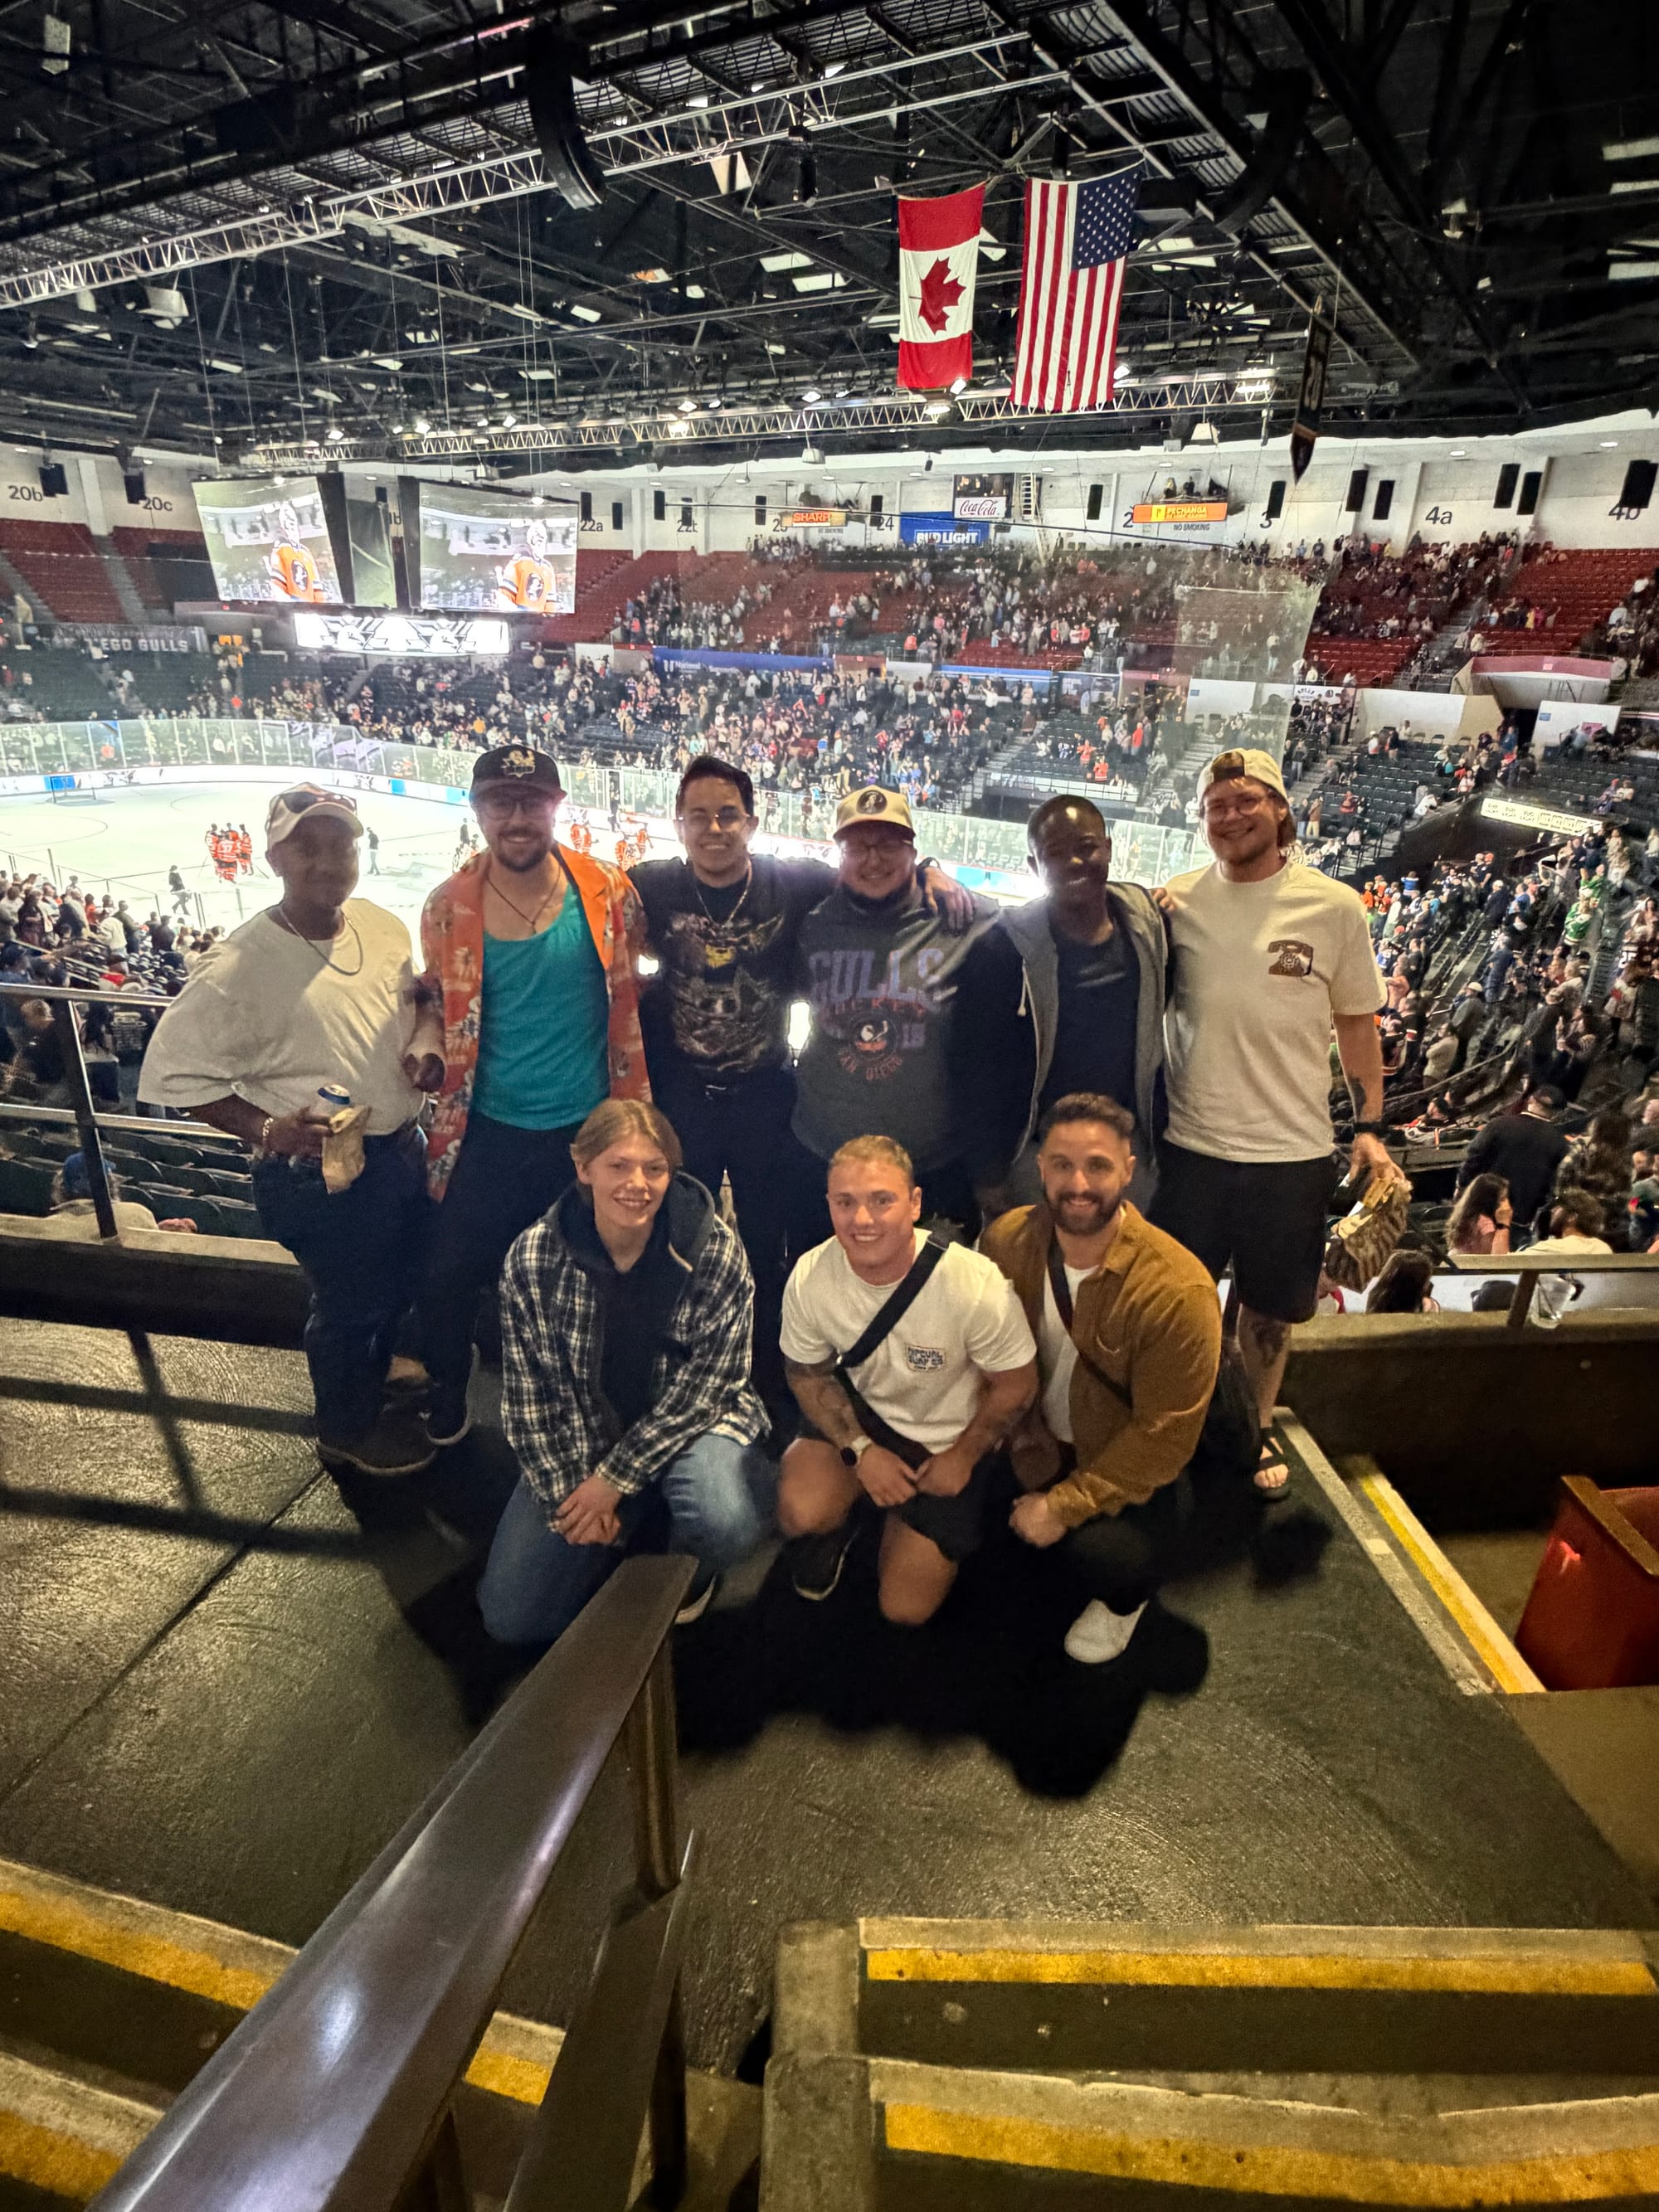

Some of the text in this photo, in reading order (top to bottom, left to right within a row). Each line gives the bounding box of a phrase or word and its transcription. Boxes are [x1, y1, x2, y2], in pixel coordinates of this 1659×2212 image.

[7, 485, 43, 502] 20b
[143, 497, 173, 511] 20c
[792, 512, 830, 523] SHARP
[1425, 506, 1452, 524] 4a
[1608, 503, 1641, 521] 4b
[580, 518, 603, 532] 22a
[942, 532, 979, 544] LIGHT
[138, 639, 188, 653] GULLS
[808, 948, 944, 1005] GULLS
